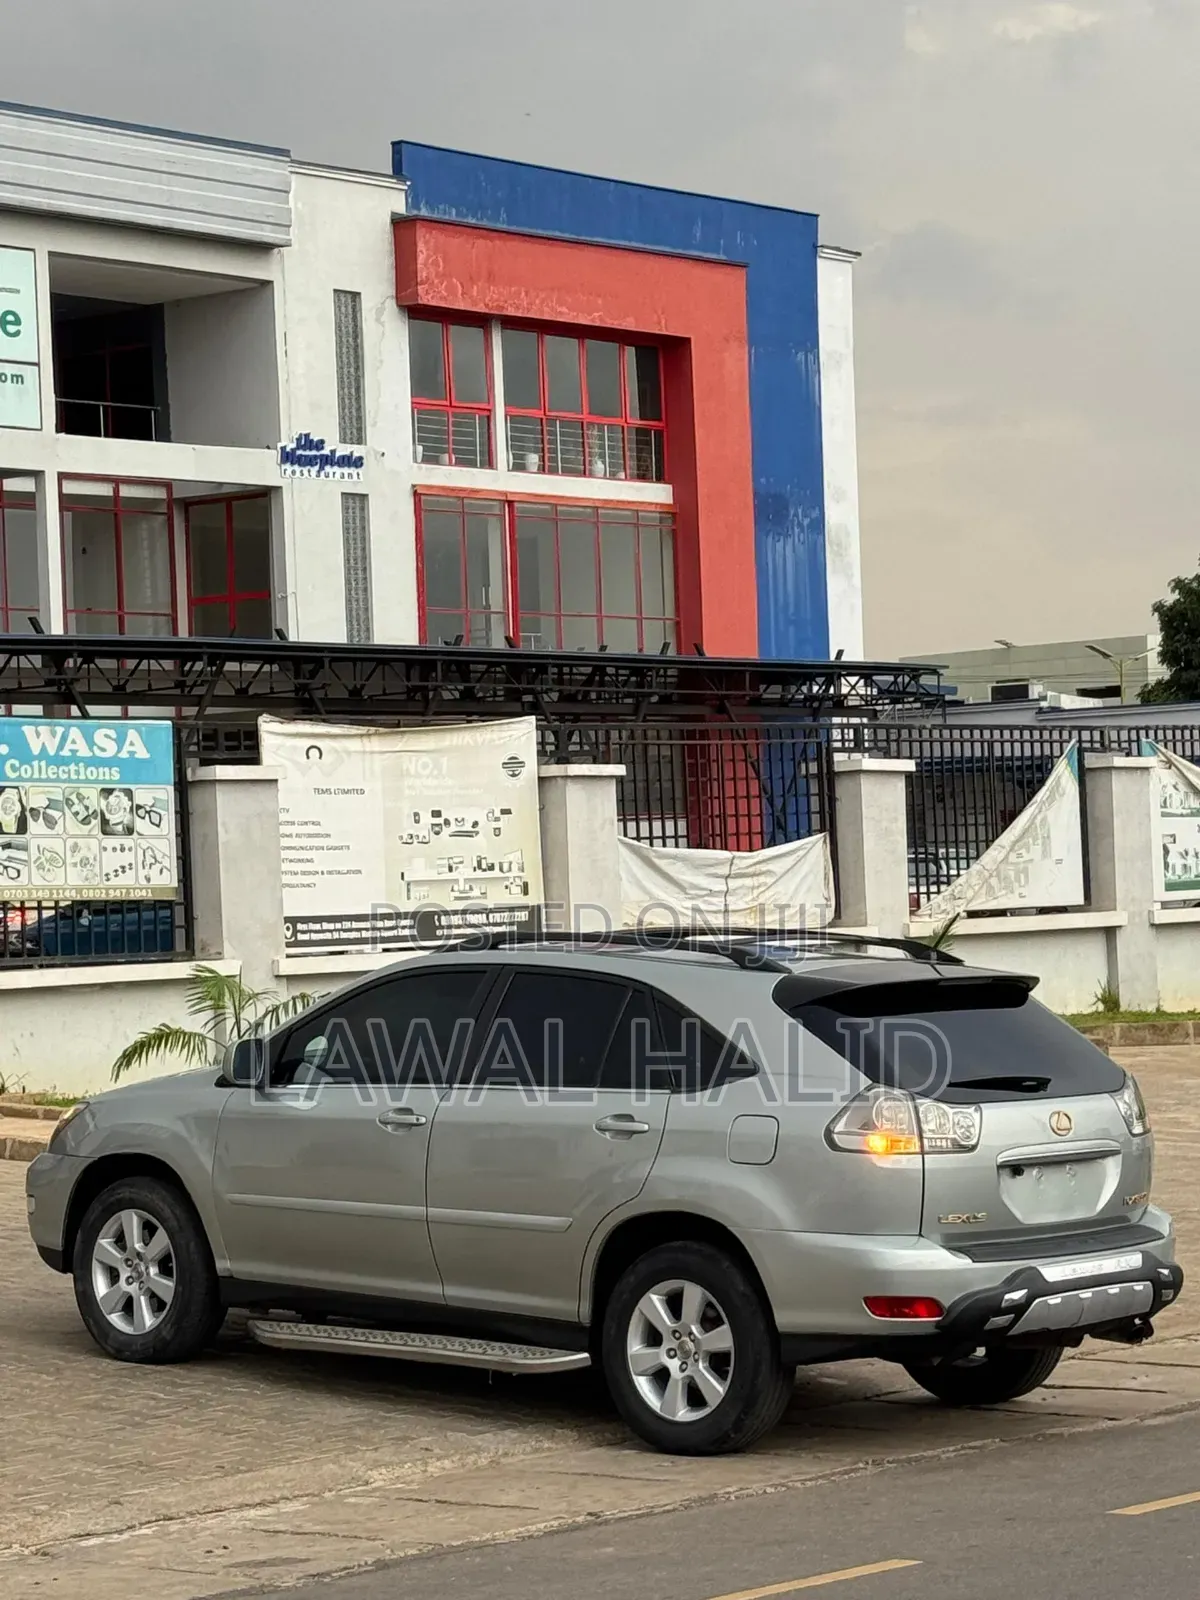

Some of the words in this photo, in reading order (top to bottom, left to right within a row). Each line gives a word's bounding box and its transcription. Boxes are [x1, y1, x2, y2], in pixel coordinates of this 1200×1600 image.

[295, 432, 325, 452] the
[283, 467, 361, 480] restaurant
[22, 725, 150, 759] WASA
[4, 759, 121, 780] Collections
